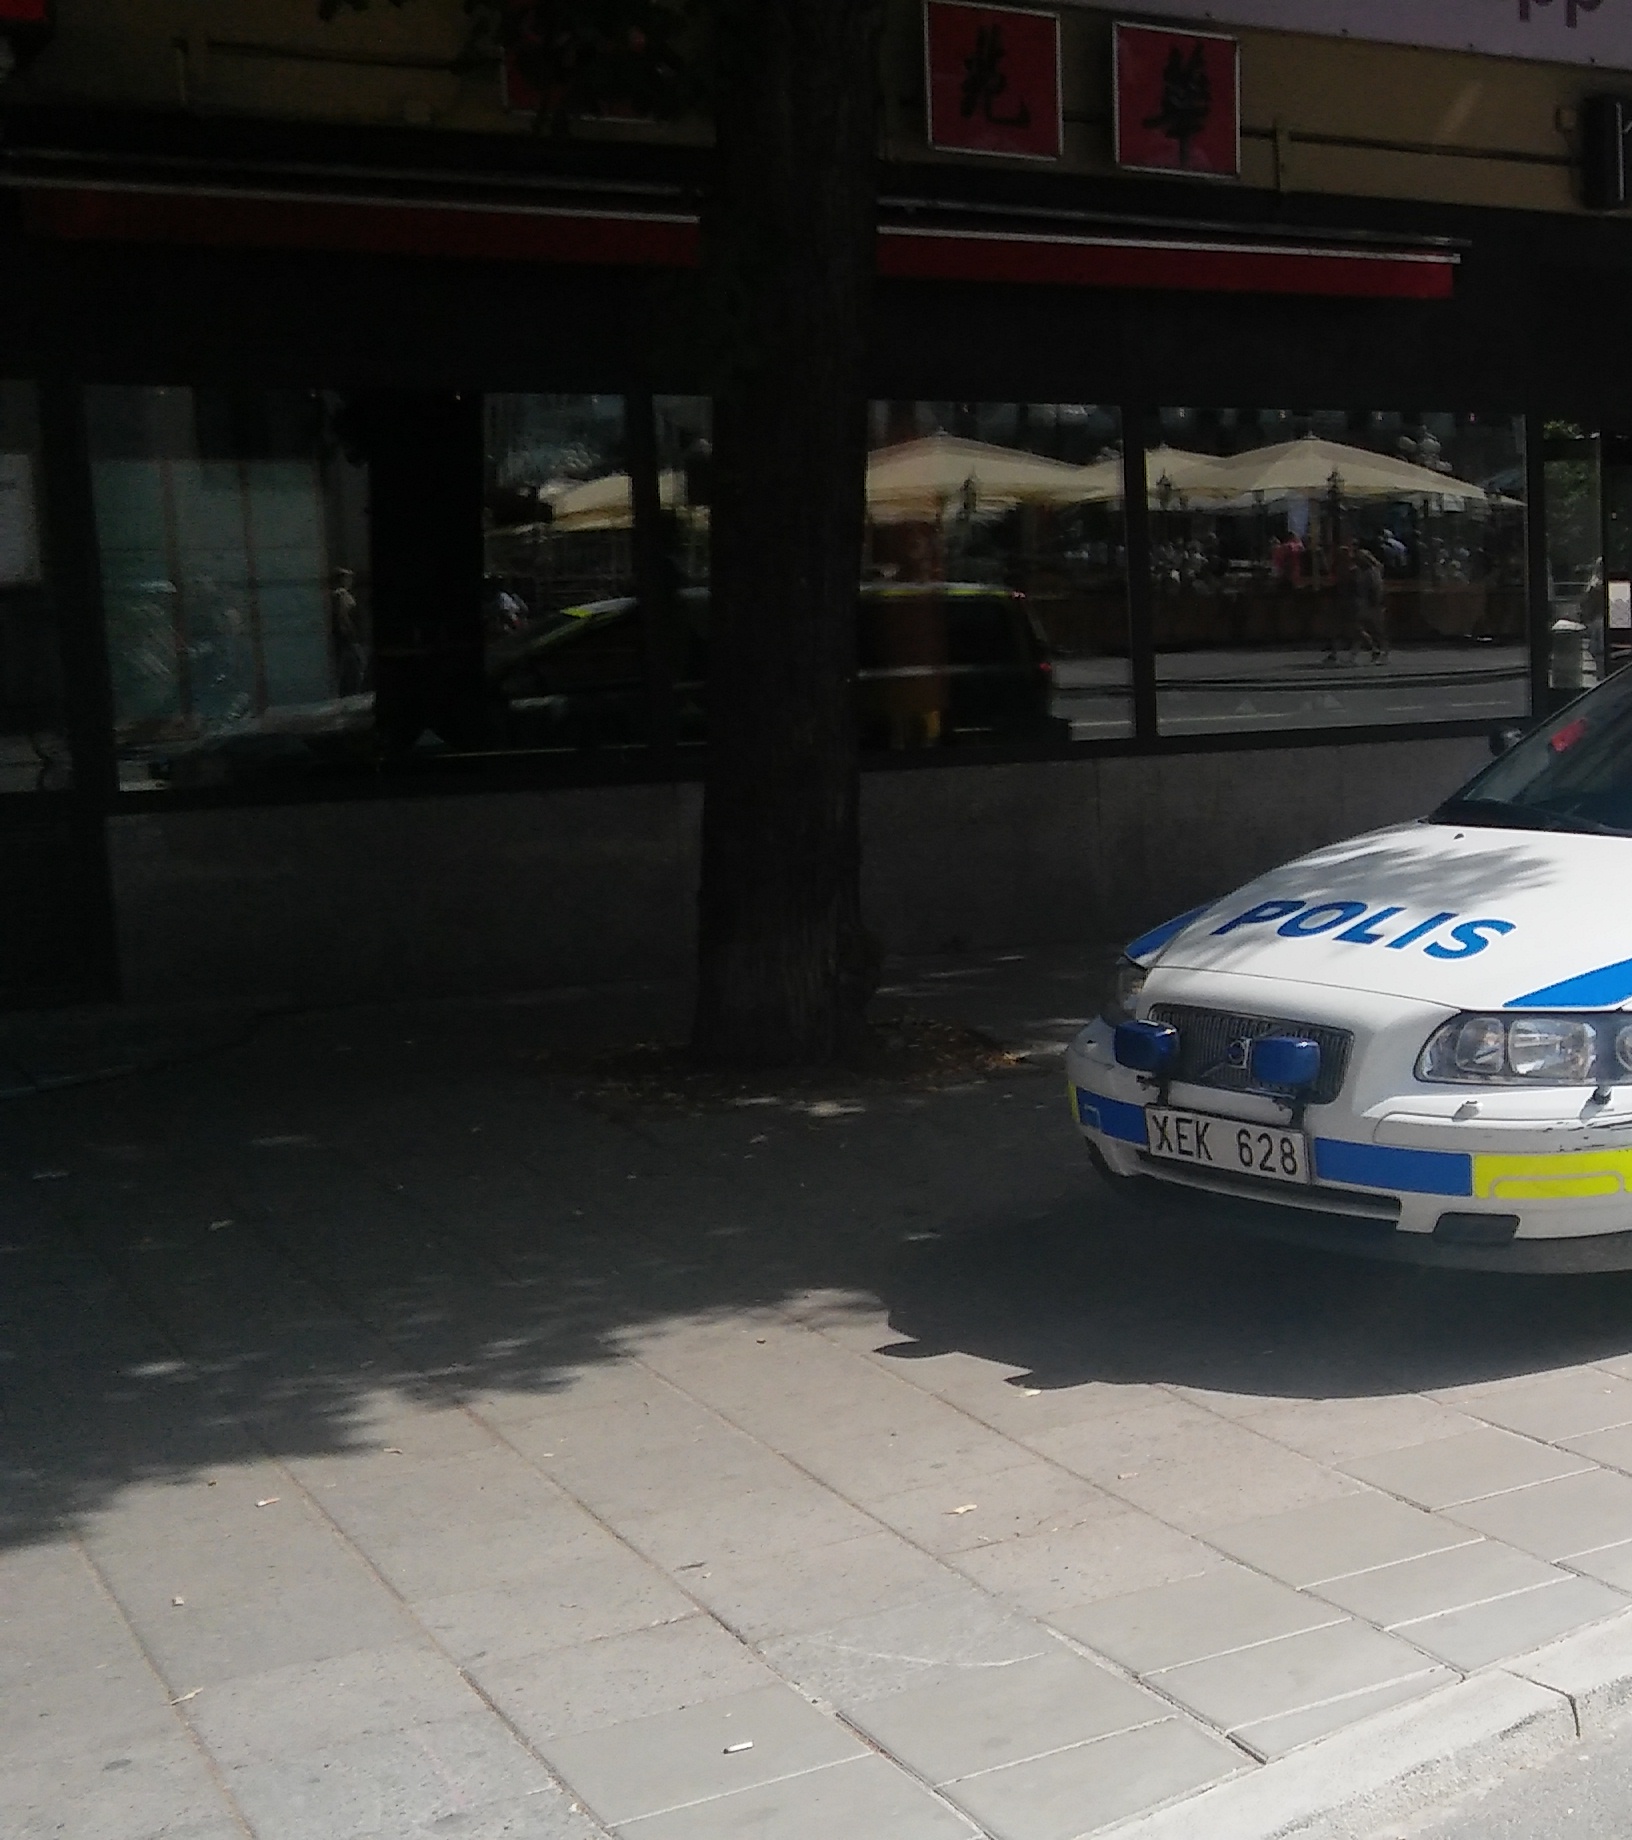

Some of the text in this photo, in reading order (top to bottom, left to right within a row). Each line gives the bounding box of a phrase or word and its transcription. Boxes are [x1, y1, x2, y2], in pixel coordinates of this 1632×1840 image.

[1208, 899, 1519, 960] POLIS
[1152, 1114, 1298, 1176] XEK 628
